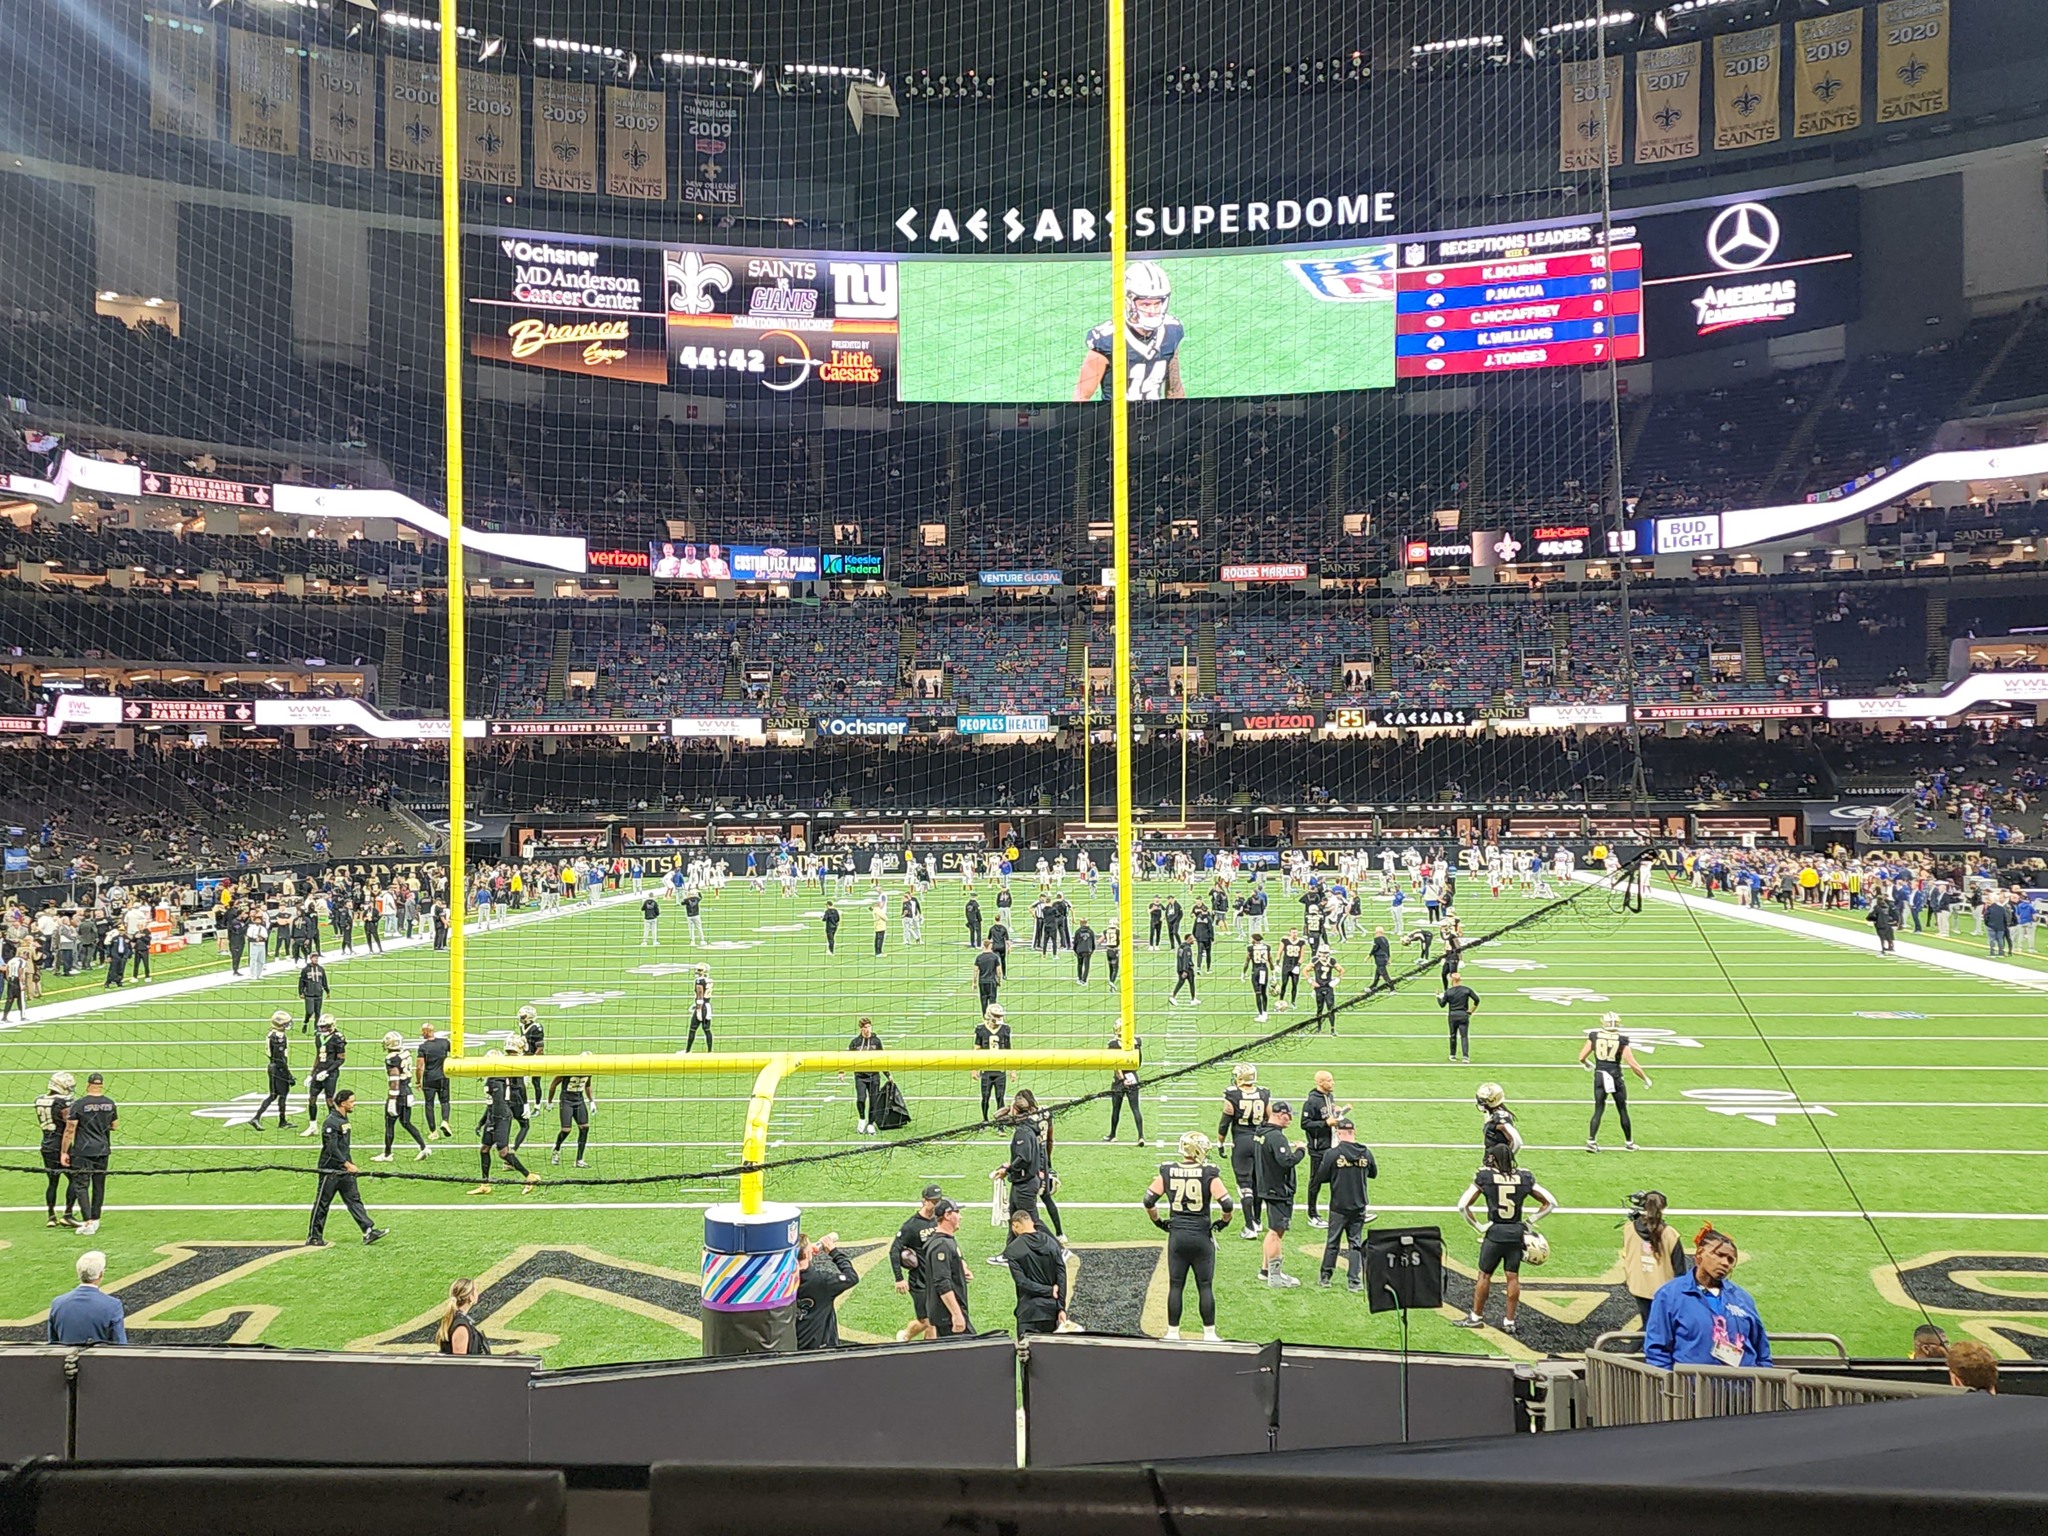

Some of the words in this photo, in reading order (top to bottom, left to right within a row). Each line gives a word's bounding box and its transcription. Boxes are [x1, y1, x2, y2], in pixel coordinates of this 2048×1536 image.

[1888, 21, 1939, 46] 2020
[1805, 39, 1850, 63] 2019
[1724, 55, 1769, 77] 2018
[320, 74, 362, 96] 1991
[1648, 71, 1689, 92] 2017
[395, 85, 441, 105] 2000
[467, 97, 512, 117] 2006
[695, 99, 726, 109] WORLD
[1882, 96, 1943, 119] SAINTS
[542, 106, 588, 124] 2009
[614, 113, 659, 132] 2009
[1799, 111, 1857, 134] SAINTS
[689, 121, 732, 137] 2009
[1719, 126, 1775, 147] SAINTS
[315, 147, 370, 166] SAINTS
[1640, 141, 1694, 160] SAINTS
[389, 155, 443, 175] SAINTS
[1564, 151, 1618, 169] SAINS
[463, 166, 516, 184] SAINTS
[539, 175, 592, 190] SAINTS
[610, 181, 662, 197] SAINTS
[685, 188, 736, 203] SAINTS
[1135, 191, 1396, 237] SUPERDOME
[1440, 233, 1526, 256] RECEPTIONS
[1528, 227, 1592, 246] LEADERS
[514, 242, 599, 267] Ochsner
[748, 260, 817, 280] SAINTS
[1482, 262, 1547, 281] K.BOURNE
[1590, 255, 1606, 268] 10
[515, 265, 551, 285] MD
[551, 267, 641, 293] Anderson
[514, 284, 582, 306] Cancer
[582, 288, 642, 310] Center
[1485, 284, 1544, 301] P.NACUA
[1589, 277, 1606, 290] 10
[751, 287, 818, 312] GIANTS
[1470, 305, 1560, 324] C.MCCAFFREY
[508, 319, 629, 358] Branson
[1477, 327, 1553, 345] K.WILLIAMS
[679, 346, 766, 373] 44:42
[831, 350, 872, 367] Little
[1484, 349, 1547, 366] J.TONGES
[1594, 344, 1604, 356] 7
[820, 365, 881, 383] Caesars
[170, 477, 206, 489] PATRON
[208, 480, 244, 493] SAINTS
[170, 485, 245, 503] PARTNERS
[1670, 520, 1706, 535] BUD
[1955, 528, 2003, 540] SAINTS
[1663, 533, 1714, 549] LIGHT
[5, 543, 51, 556] SAINTS
[106, 551, 151, 564] SAINTS
[1429, 545, 1472, 556] TOYOTA
[210, 557, 254, 570] SAINTS
[587, 550, 648, 567] verizon
[845, 555, 881, 564] Keesler
[309, 563, 354, 575] SAINTS
[845, 564, 881, 574] Federal
[1139, 568, 1179, 578] SAINTS
[1223, 567, 1259, 579] ROUSES
[1261, 565, 1305, 579] MARKETS
[1321, 563, 1361, 573] SAINTS
[927, 572, 966, 582] SAINTS
[980, 573, 1024, 583] VENTURE
[1025, 572, 1061, 583] GLOBAL
[151, 703, 188, 712] PATRON
[190, 704, 225, 712] SAINTS
[288, 705, 330, 713] WWL
[1557, 707, 1601, 715] WWL
[1652, 709, 1694, 717] PATRON
[1698, 708, 1740, 717] SAINTS
[1742, 706, 1801, 716] PARTNERS
[1859, 700, 1907, 708] WWL
[151, 709, 226, 720] PARTNERS
[1069, 715, 1112, 726] SANTS
[1339, 710, 1362, 726] 25
[1384, 711, 1466, 725] CAESARS
[1479, 708, 1525, 718] SAINTS
[418, 721, 451, 730] WW
[510, 724, 552, 732] PATRON
[554, 724, 592, 732] SAINTS
[595, 723, 648, 732] PARTNERS
[697, 720, 740, 728] WWL
[766, 718, 810, 728] SAINTS
[831, 719, 907, 736] Ochsner
[960, 718, 1004, 731] PEOPLES
[1008, 717, 1047, 731] HEALTH
[1243, 713, 1315, 730] verizon
[689, 811, 859, 819] CAESARS
[866, 809, 1052, 817] SUPERDOME
[1227, 805, 1399, 813] CAESARS
[1406, 803, 1608, 813] SUPERDOME
[882, 855, 900, 870] 20
[1321, 966, 1330, 979] 7
[1595, 1038, 1621, 1062] 87
[84, 1103, 113, 1112] SAINTS
[1238, 1100, 1265, 1126] 78
[1170, 1178, 1203, 1212] 79
[1499, 1185, 1516, 1220] 5
